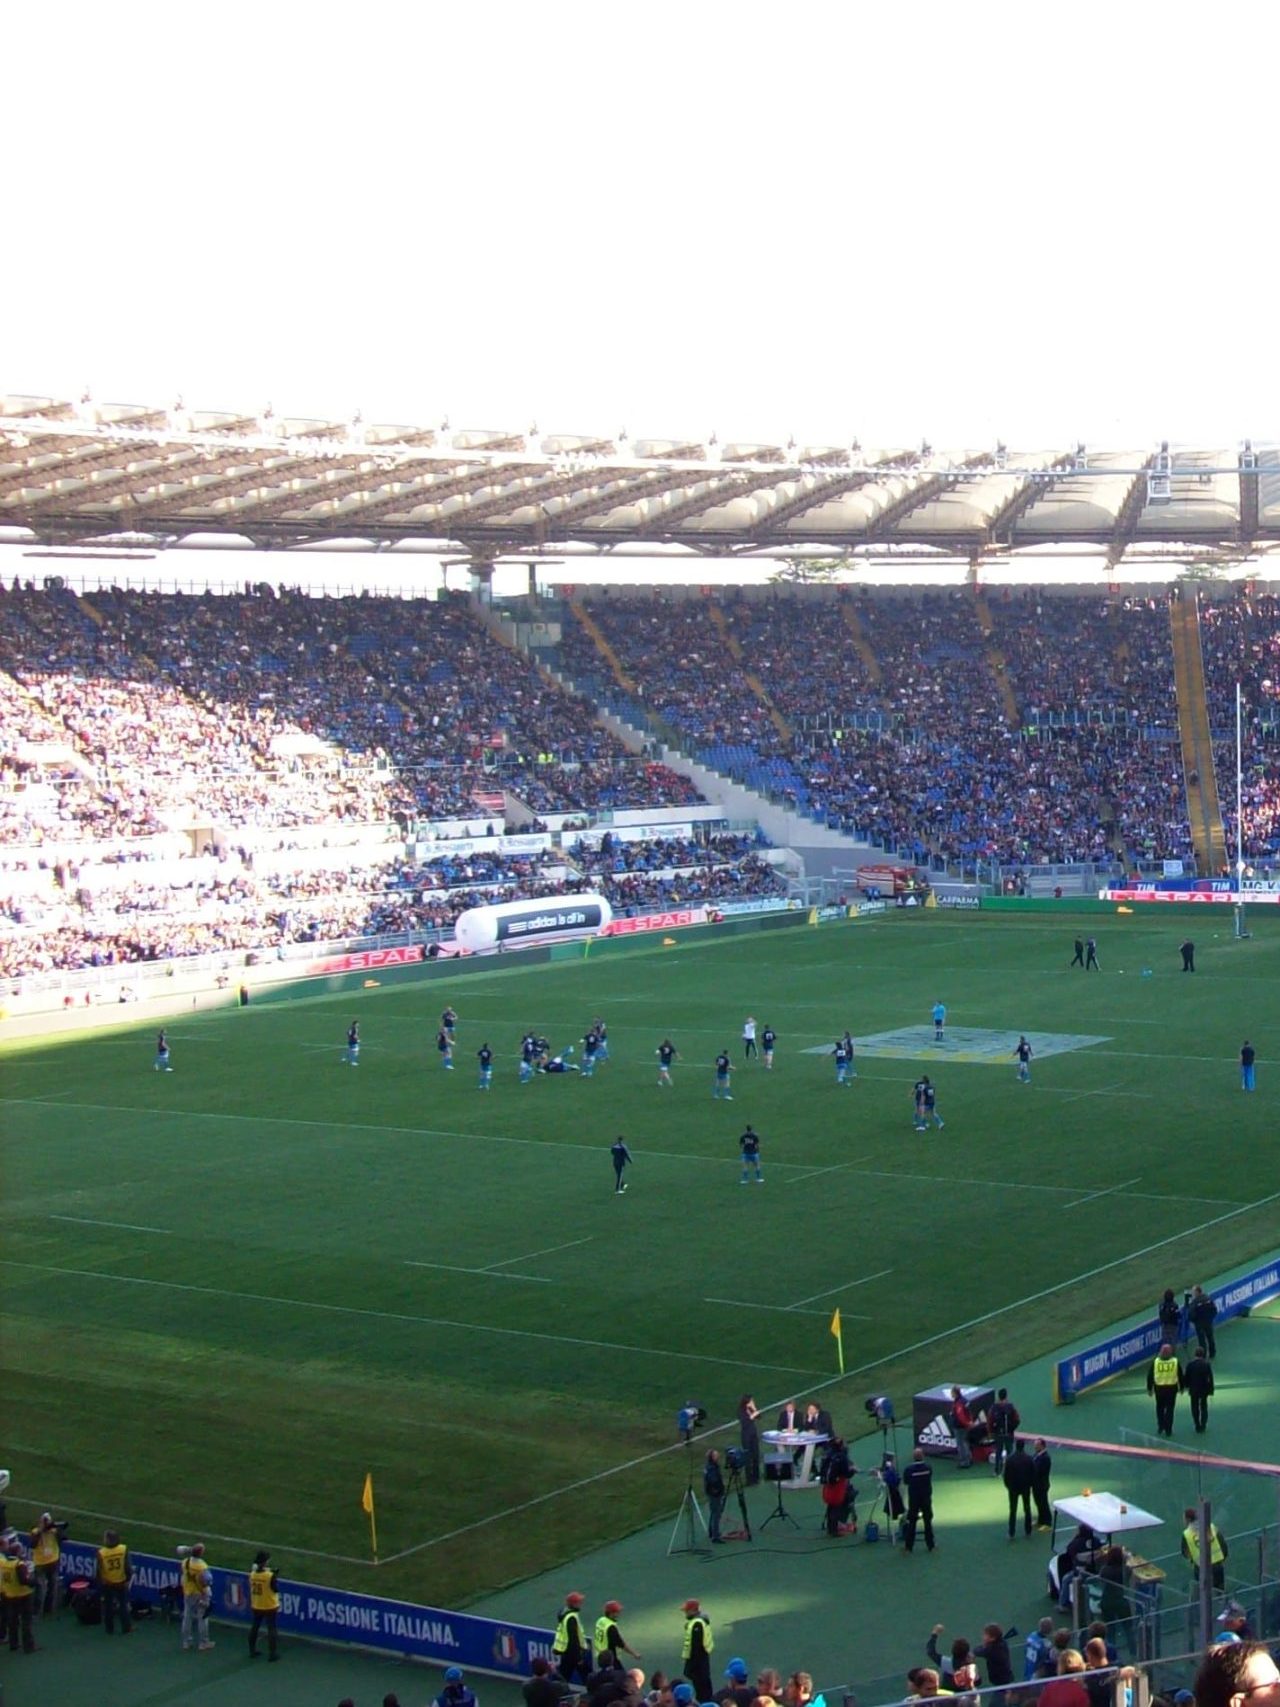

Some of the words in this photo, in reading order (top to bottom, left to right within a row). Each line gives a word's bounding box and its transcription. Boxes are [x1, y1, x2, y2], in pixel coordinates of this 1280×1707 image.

[1211, 882, 1231, 891] TIM
[528, 915, 557, 930] adidas
[1083, 1351, 1110, 1377] RUGBY,
[1110, 1334, 1145, 1363] PASSIONE
[918, 1433, 957, 1448] adidas
[60, 1552, 98, 1578] PASSI
[106, 1558, 121, 1571] 33
[308, 1598, 380, 1632] PASSIONE
[383, 1612, 460, 1647] ITALIANA.
